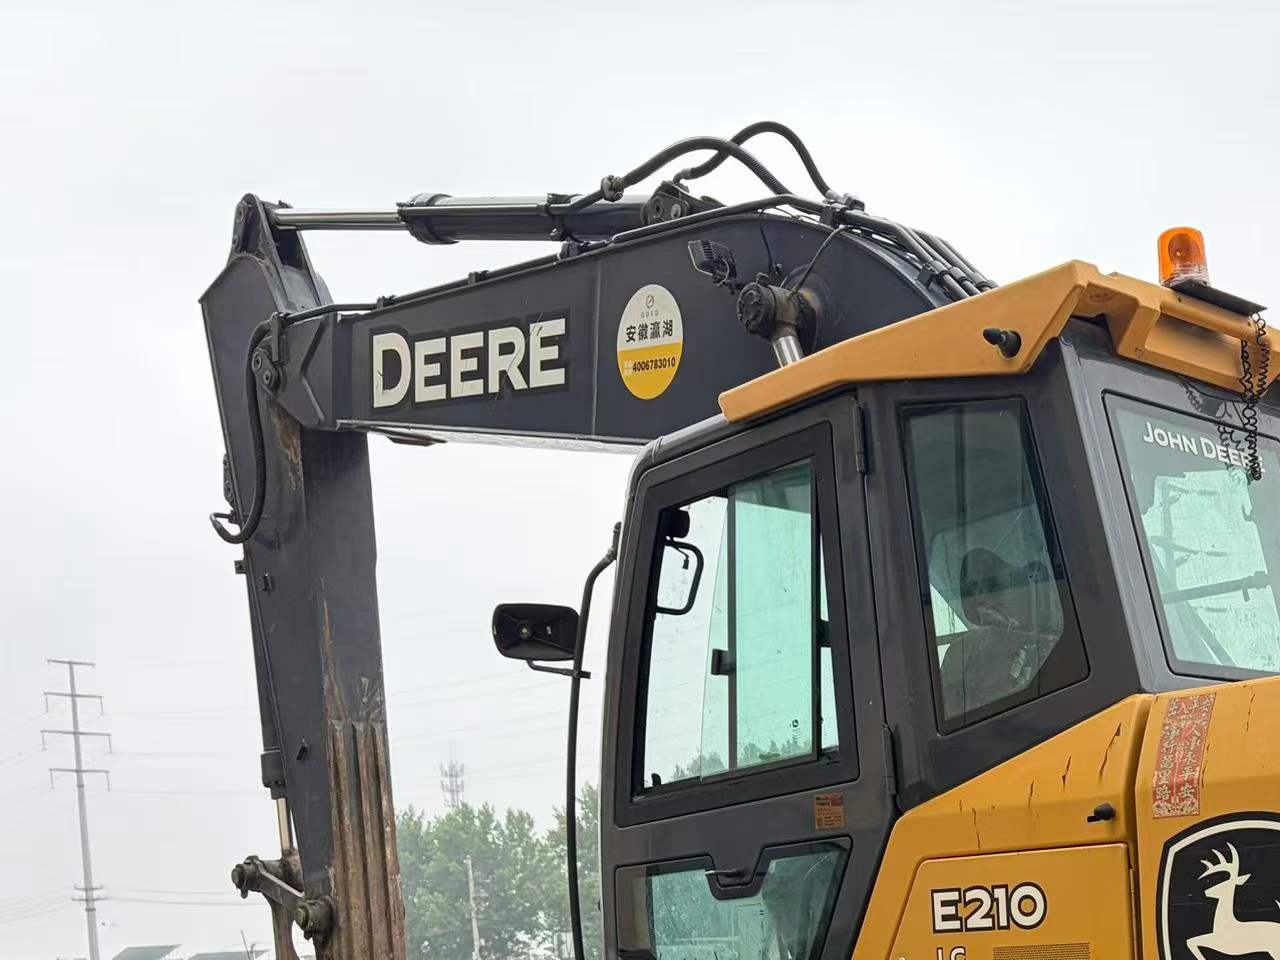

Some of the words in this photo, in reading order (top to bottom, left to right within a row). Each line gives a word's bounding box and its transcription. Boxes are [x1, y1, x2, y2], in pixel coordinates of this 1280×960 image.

[372, 317, 567, 409] DEERE
[633, 357, 676, 372] 4006783010
[1143, 421, 1199, 456] JOHN
[931, 881, 1048, 933] E210
